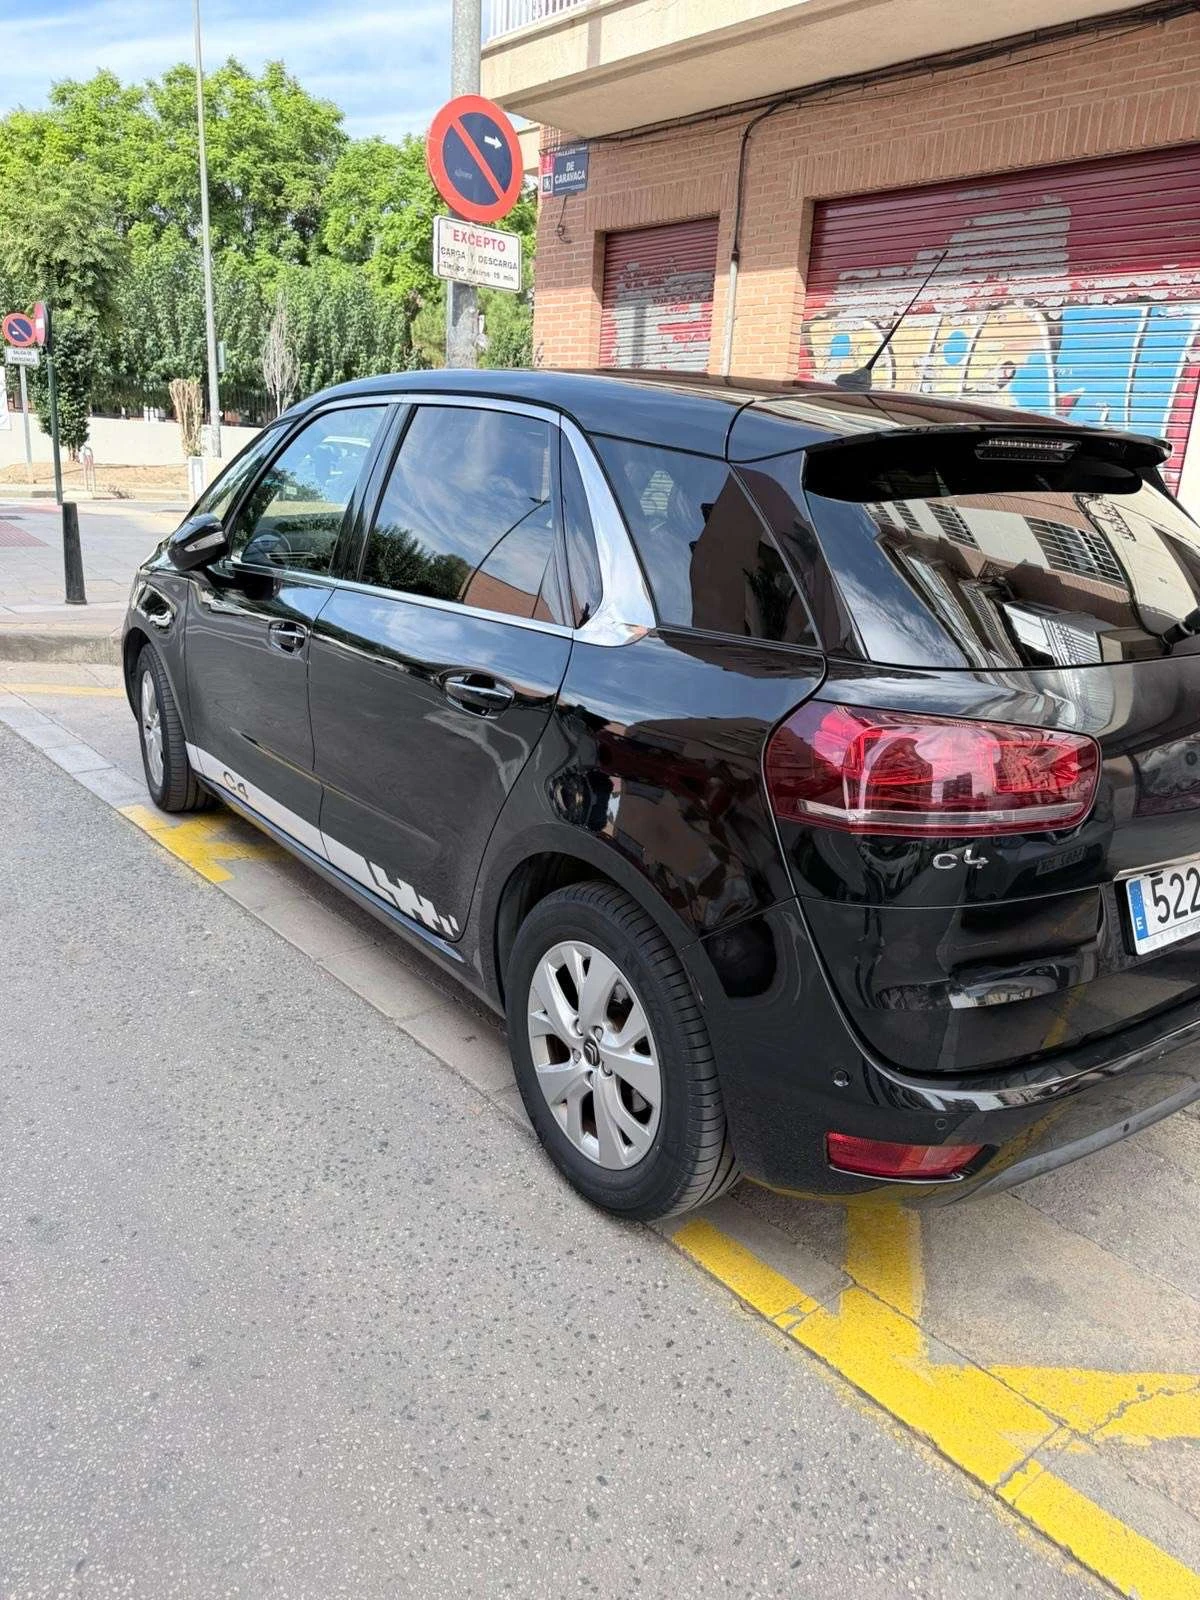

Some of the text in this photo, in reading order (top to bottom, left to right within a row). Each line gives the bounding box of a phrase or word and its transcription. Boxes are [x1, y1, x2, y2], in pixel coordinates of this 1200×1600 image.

[566, 161, 575, 172] DE
[554, 170, 586, 185] CARAVACA
[453, 229, 506, 252] EXCEPTO
[440, 246, 466, 259] CARGA
[478, 255, 518, 270] DESCARGA
[932, 849, 989, 870] C4
[1150, 867, 1200, 924] 522
[1135, 917, 1144, 931] E
